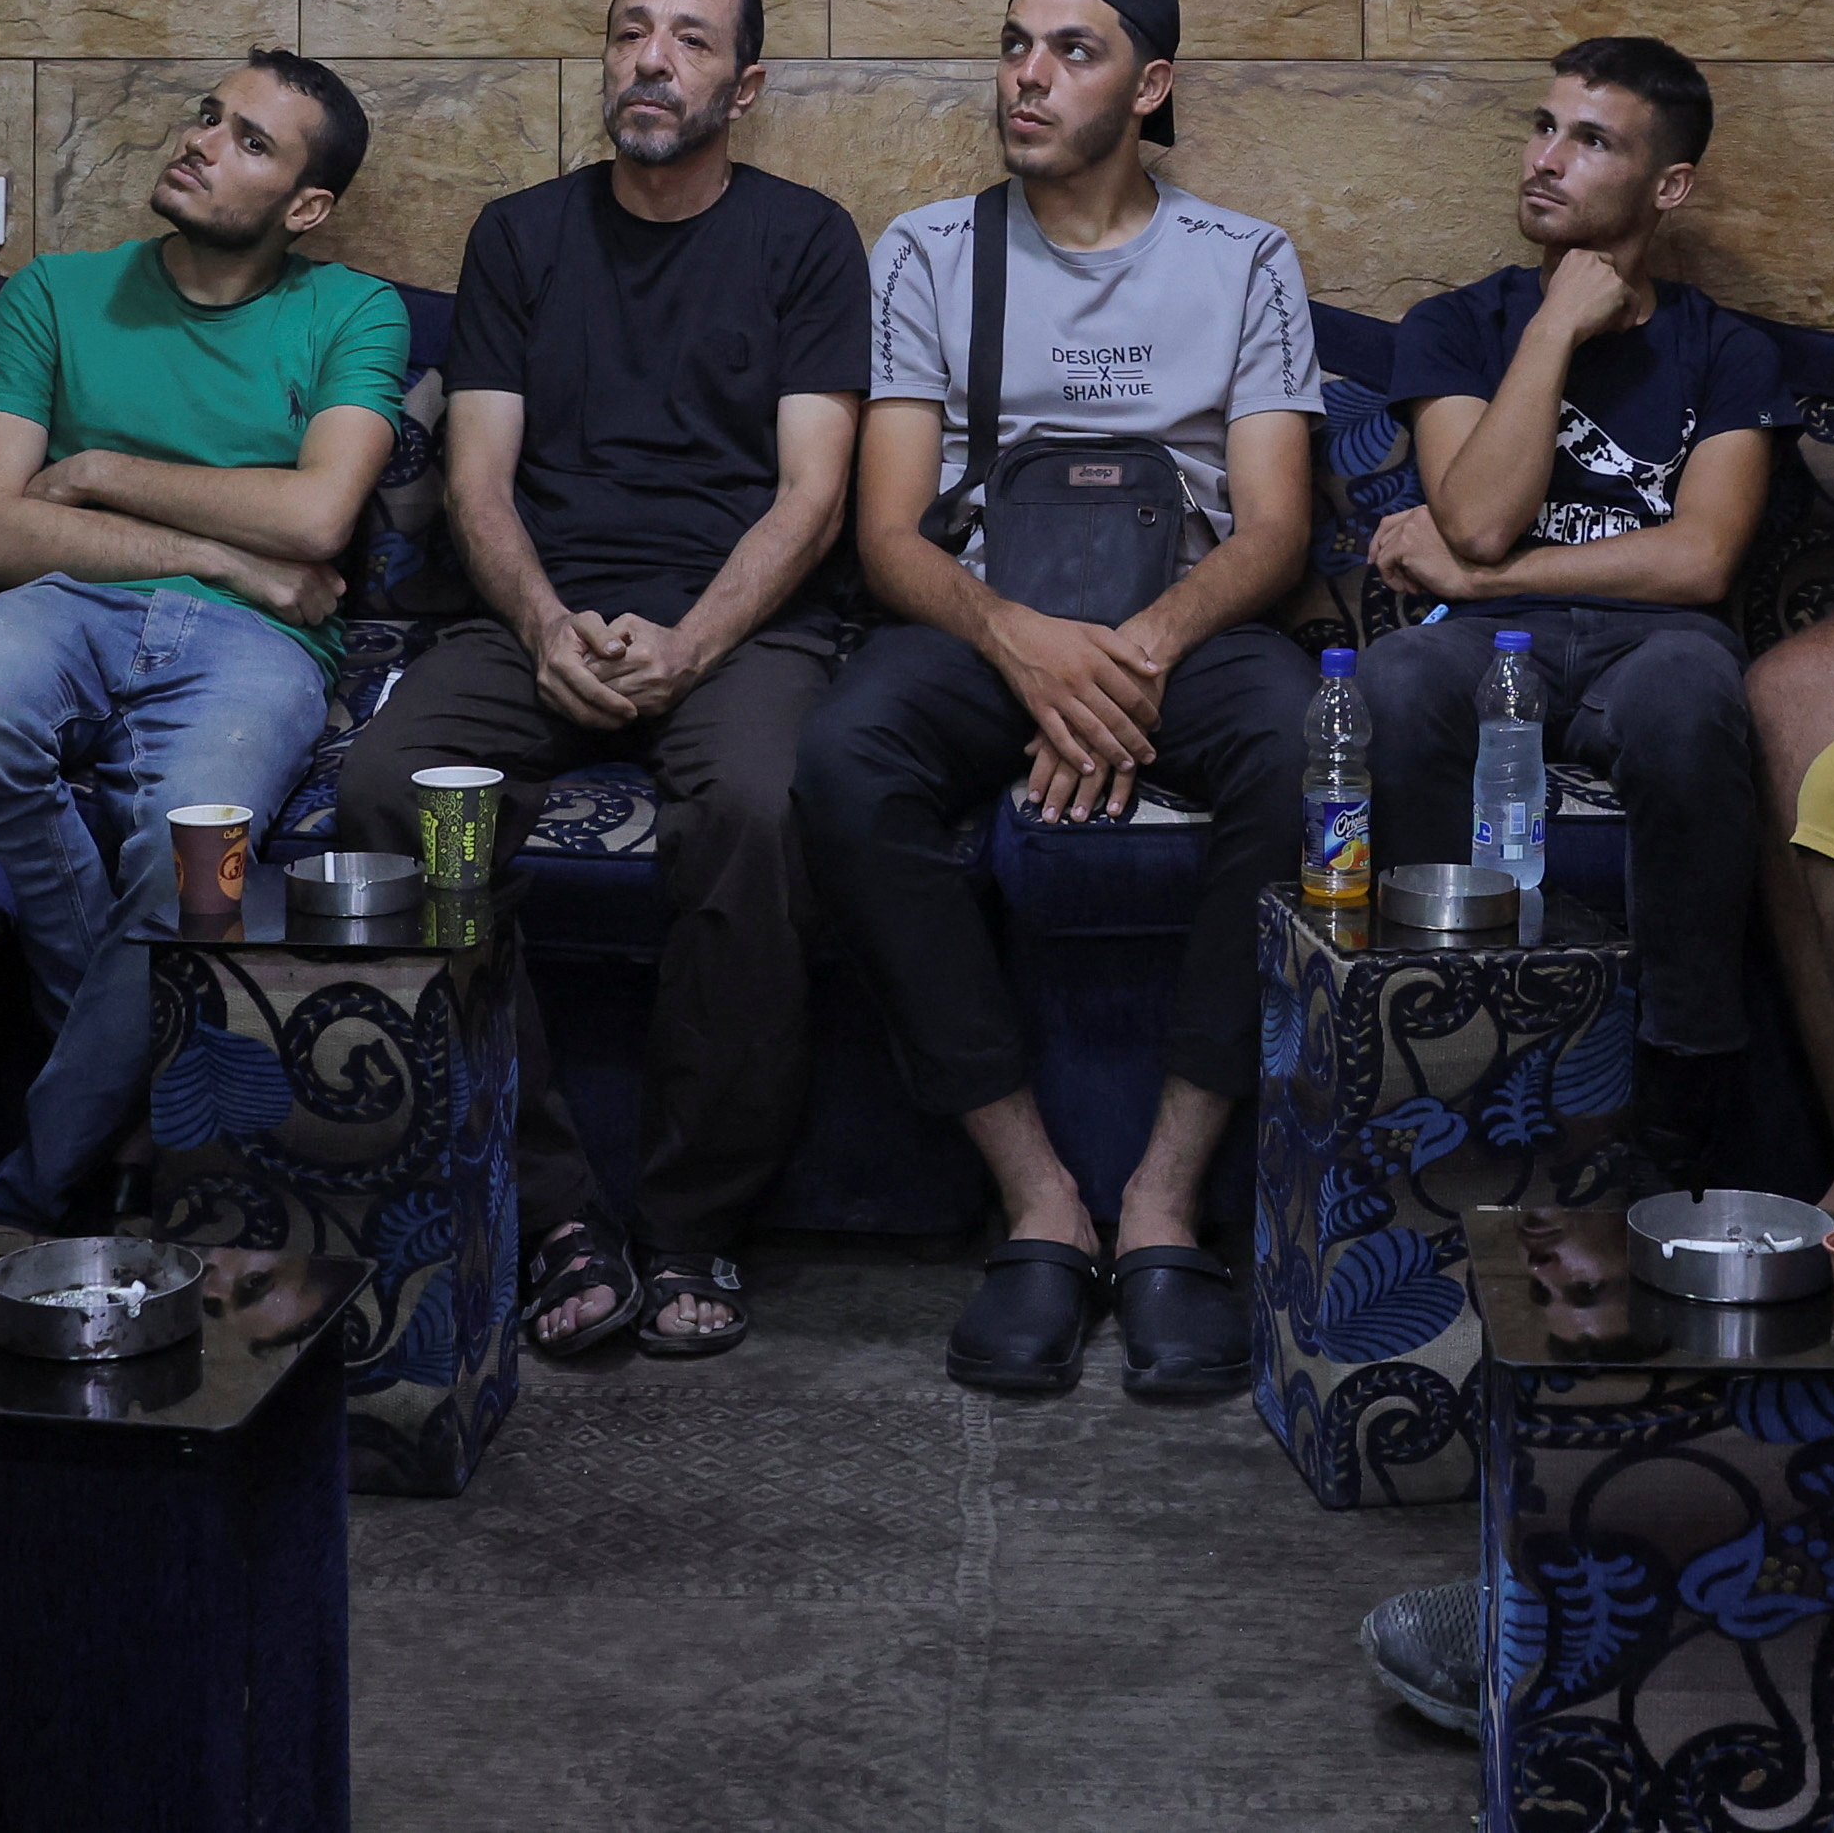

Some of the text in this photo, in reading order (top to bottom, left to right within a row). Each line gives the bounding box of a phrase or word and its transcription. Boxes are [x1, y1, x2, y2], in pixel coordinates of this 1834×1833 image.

[1052, 344, 1154, 366] DESIGN BY
[1097, 365, 1113, 382] X
[1062, 383, 1154, 402] SHAN YUE
[462, 821, 476, 862] coffee
